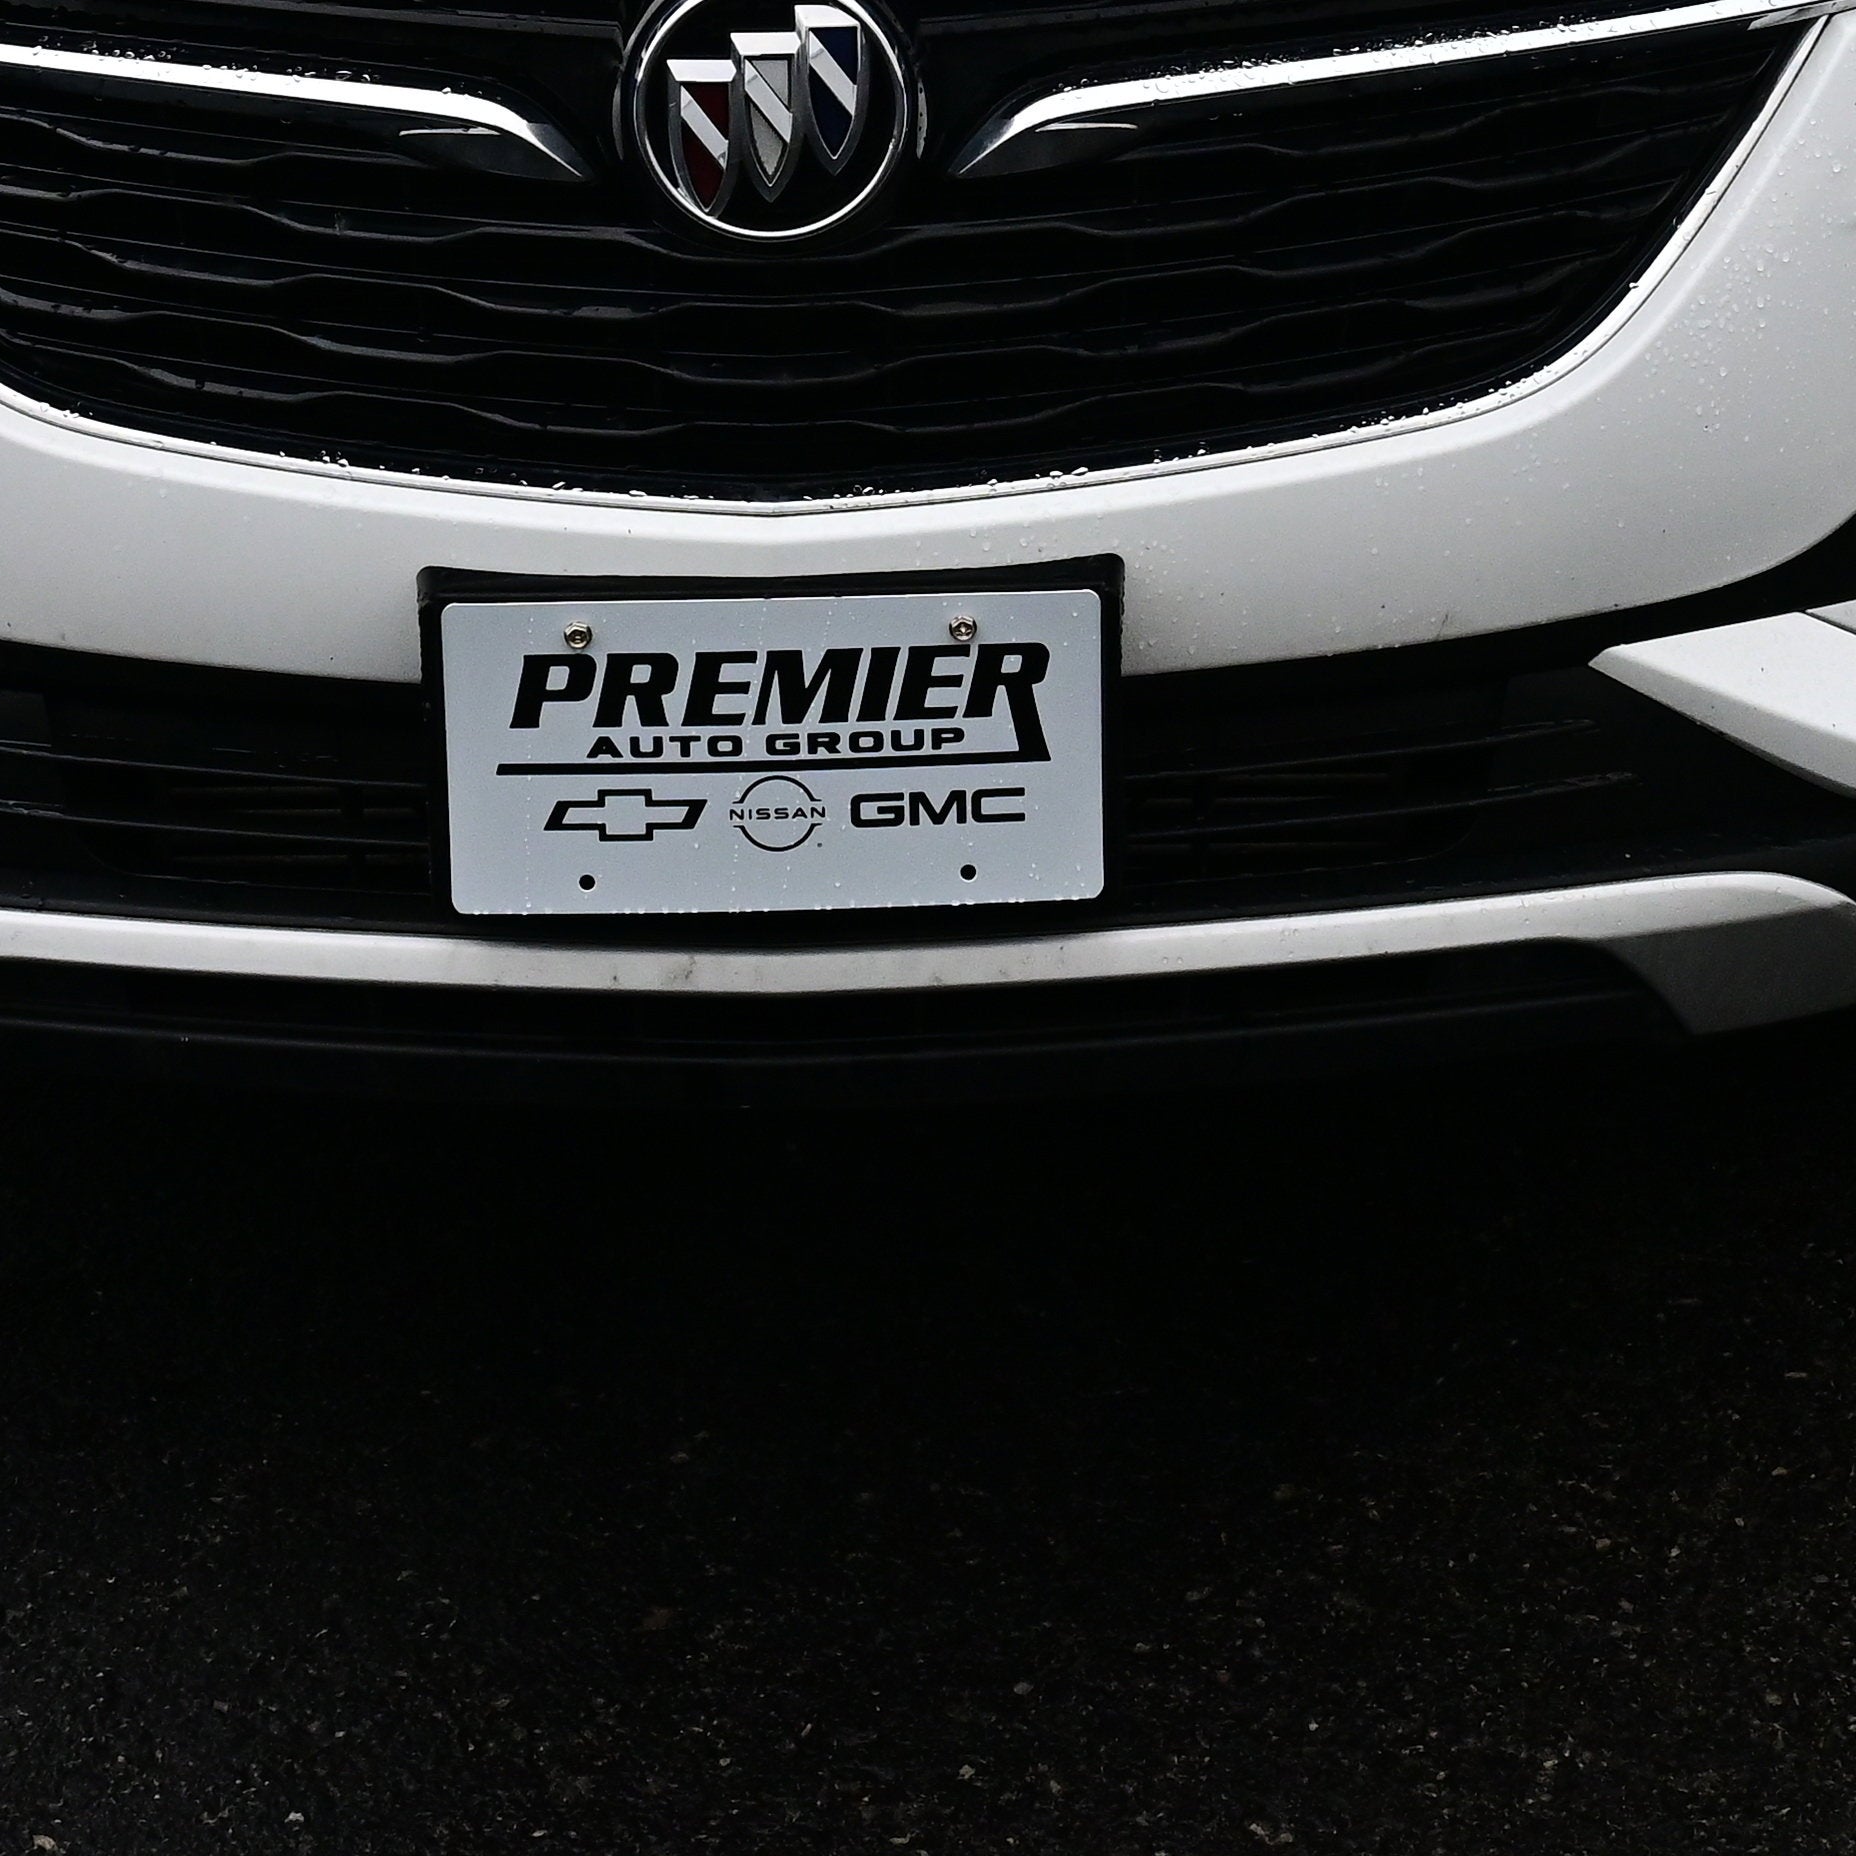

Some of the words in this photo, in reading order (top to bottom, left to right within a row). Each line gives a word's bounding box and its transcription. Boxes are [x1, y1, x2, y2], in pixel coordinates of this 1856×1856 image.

[510, 642, 1051, 762] PREMIER
[587, 734, 743, 758] AUTO
[765, 727, 965, 756] GROUP
[729, 806, 826, 821] NISSAN
[850, 787, 1026, 829] GMC
